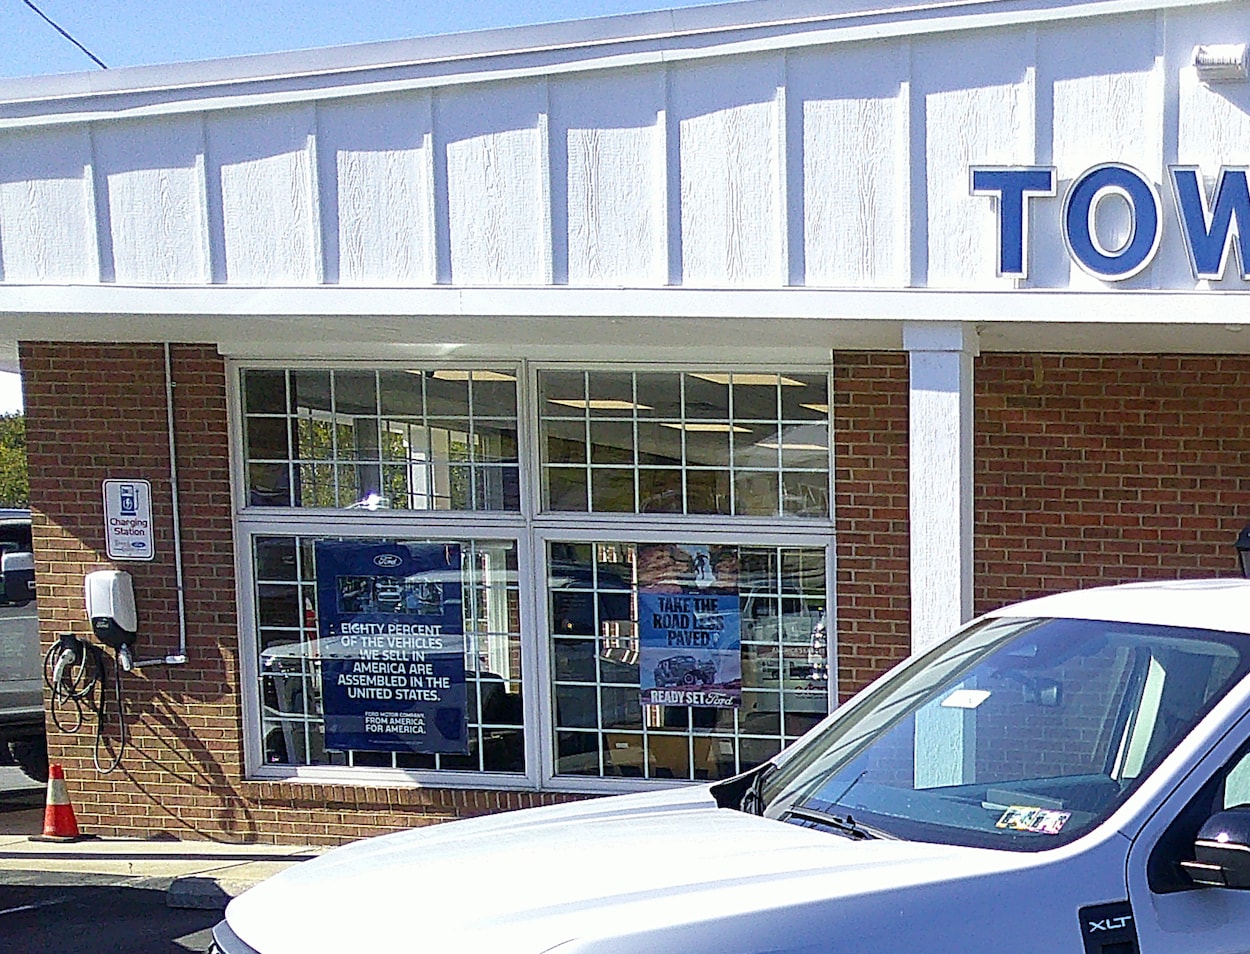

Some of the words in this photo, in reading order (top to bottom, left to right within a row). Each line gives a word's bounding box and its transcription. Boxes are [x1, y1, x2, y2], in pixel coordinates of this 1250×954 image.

[110, 517, 148, 528] Charging
[114, 527, 145, 536] Station
[658, 597, 690, 613] TAKE
[693, 598, 718, 613] THE
[653, 613, 690, 629] ROAD
[341, 622, 385, 634] EIGHTY
[387, 624, 442, 637] PERCENT
[341, 635, 358, 647] OF
[361, 636, 385, 648] THE
[387, 637, 443, 650] VEHICLES
[360, 648, 380, 661] WE
[382, 650, 409, 662] SELL
[412, 651, 425, 662] IN
[353, 661, 406, 675] AMERICA
[409, 663, 433, 676] ARE
[337, 674, 407, 687] ASSEMBLED
[410, 676, 423, 688] IN
[426, 677, 450, 689] THE
[347, 687, 393, 700] UNITED
[395, 689, 441, 702] STATES.
[650, 690, 685, 704] READY
[686, 691, 705, 705] SET
[705, 692, 737, 706] Ford
[365, 717, 388, 725] FROM
[390, 717, 426, 726] AMERICA.
[366, 724, 384, 733] FOR
[385, 725, 427, 734] AMERICA.
[1088, 916, 1132, 933] XLT
